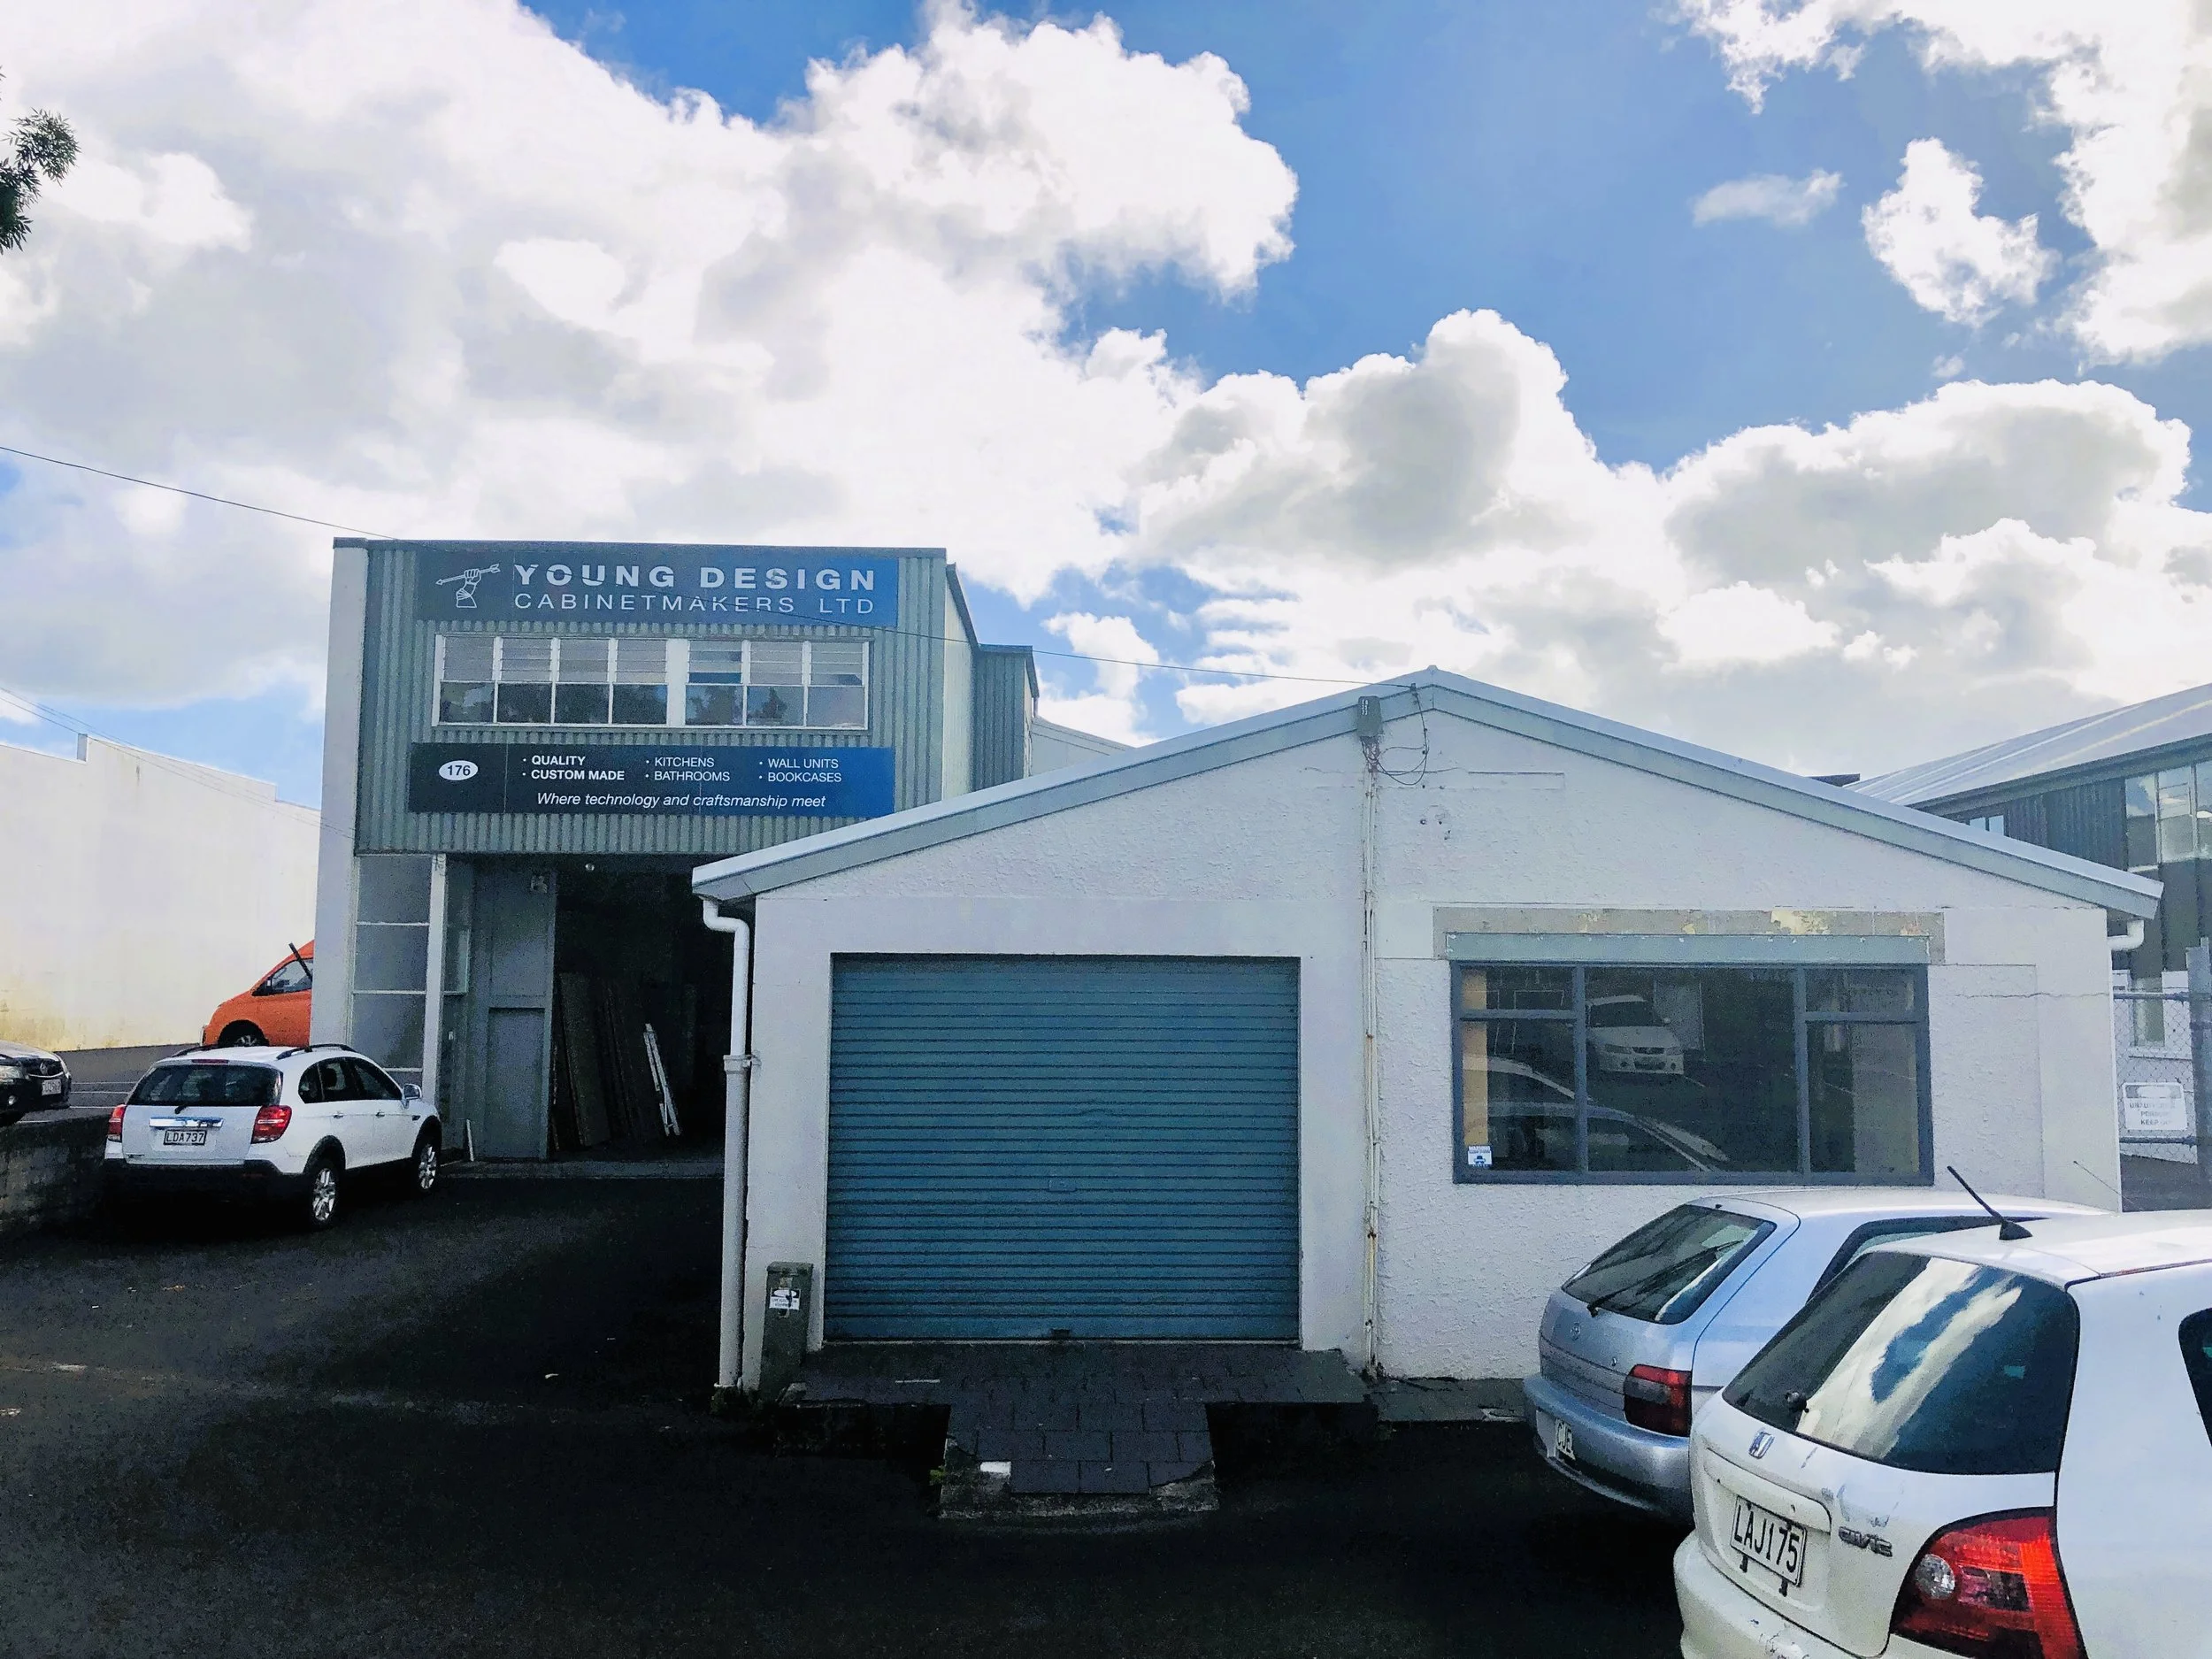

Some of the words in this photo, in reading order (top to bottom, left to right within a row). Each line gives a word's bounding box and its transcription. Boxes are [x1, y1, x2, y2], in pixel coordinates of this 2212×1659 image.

[514, 564, 674, 588] YOUNG
[700, 566, 874, 591] DESIGN
[514, 593, 795, 613] CABINETMAKERS
[819, 597, 874, 614] LTD
[531, 755, 586, 766] QUALITY
[654, 757, 715, 767] KITCHENS
[768, 758, 801, 769] WALL
[803, 758, 839, 769] UNITS
[447, 764, 471, 776] 176
[531, 769, 586, 780] CUSTOM
[588, 770, 625, 780] MADE
[654, 771, 731, 781] BATHROOMS
[768, 772, 842, 782] BOOKCASES
[537, 792, 580, 805] Where
[585, 793, 660, 809] technology
[663, 794, 690, 806] and
[693, 795, 787, 810] craftsmanship
[791, 795, 826, 807] meet
[165, 1133, 205, 1143] LDA737
[1733, 1504, 1801, 1573] LAJ175
